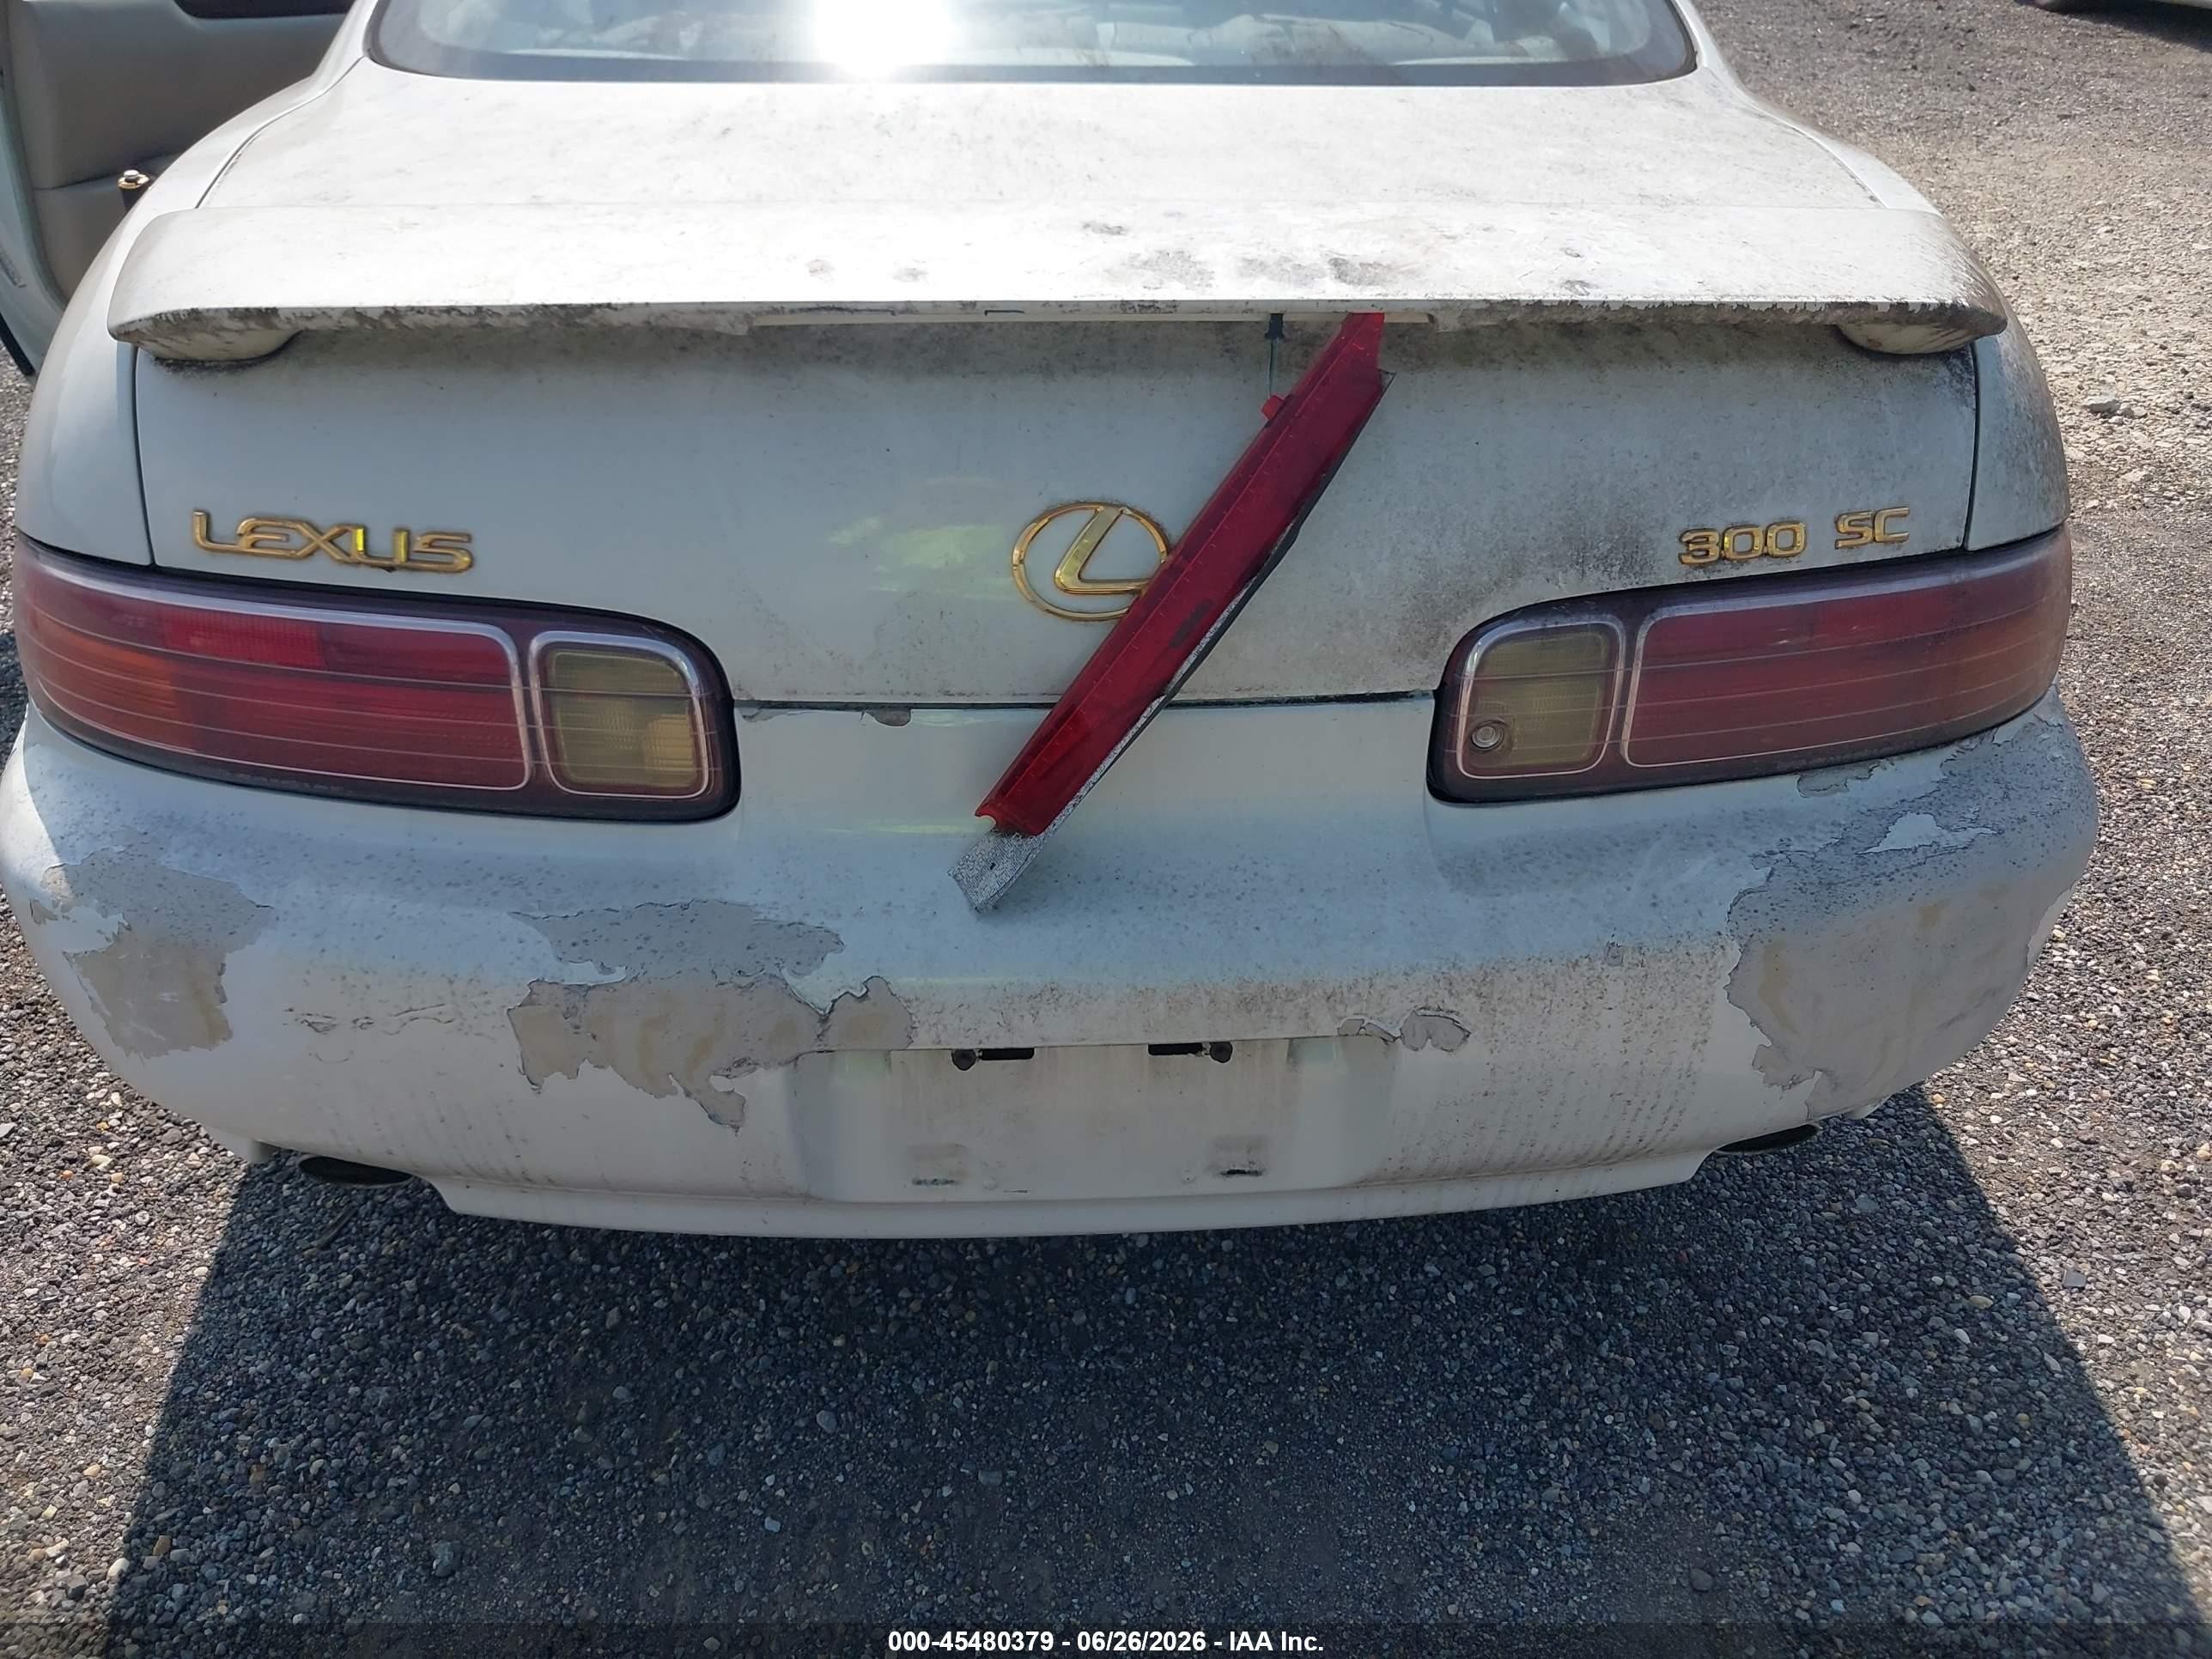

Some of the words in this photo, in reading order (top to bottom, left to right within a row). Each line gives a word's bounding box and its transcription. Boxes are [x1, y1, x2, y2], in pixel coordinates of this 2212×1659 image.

[191, 509, 473, 573] LEXUS
[1679, 520, 1807, 565] 300
[1835, 506, 1910, 550] SC
